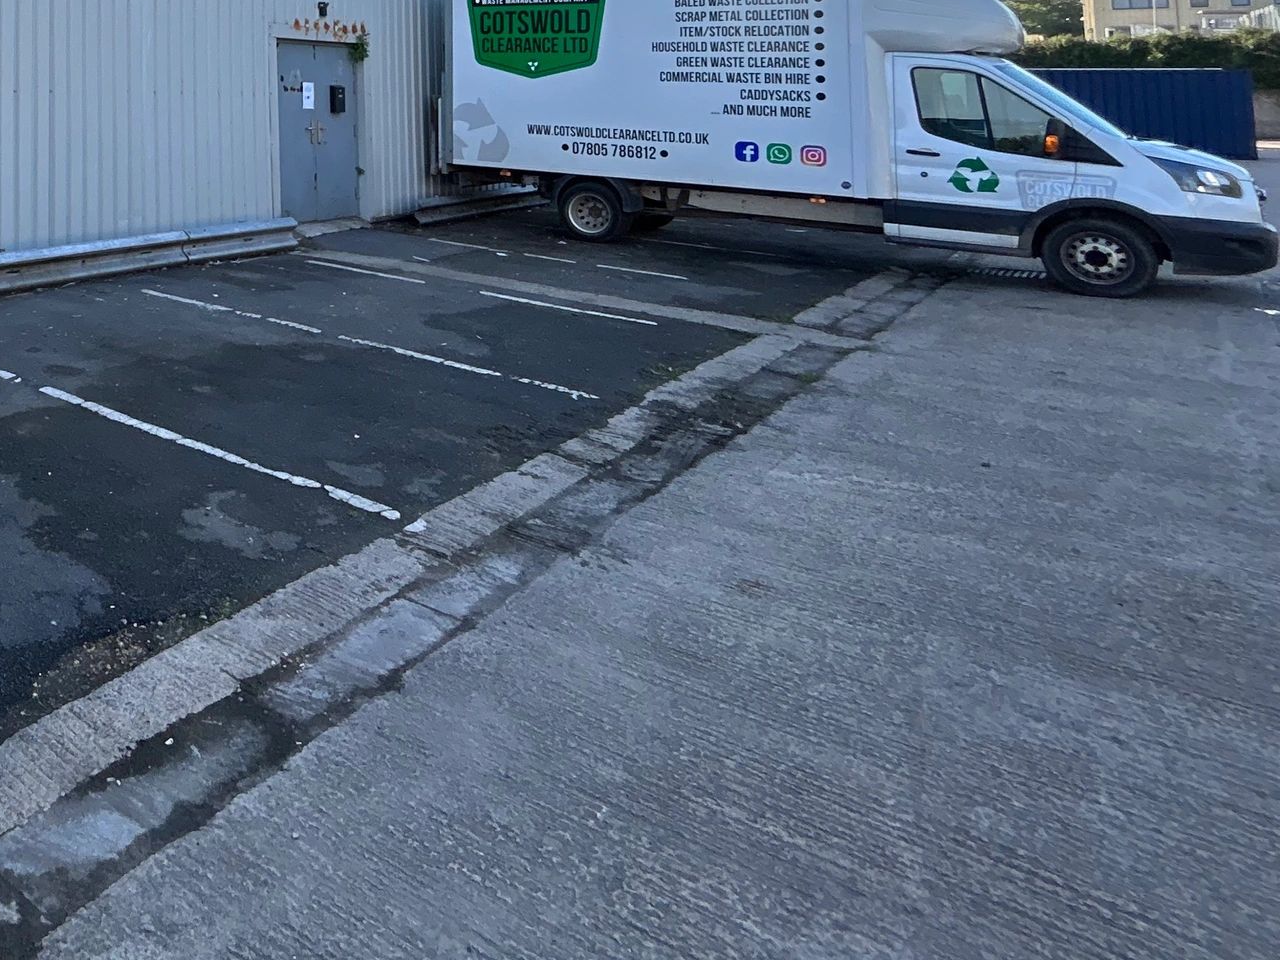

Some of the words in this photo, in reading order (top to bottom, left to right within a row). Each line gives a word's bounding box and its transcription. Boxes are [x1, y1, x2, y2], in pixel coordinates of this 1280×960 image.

[480, 9, 590, 34] COTSWOLD
[675, 11, 706, 22] SCRAP
[709, 10, 742, 22] METAL
[745, 9, 809, 21] COLLECTION
[680, 26, 742, 37] ITEM/STOCK
[745, 25, 810, 36] RELOCATION
[482, 37, 558, 53] CLEARANCE
[563, 37, 588, 53] LTD
[652, 41, 707, 52] HOUSEHOLD
[710, 41, 744, 52] WASTE
[747, 41, 810, 52] CLEARANCE
[676, 57, 707, 68] GREEN
[710, 57, 744, 68] WASTE
[748, 57, 810, 68] CLEARANCE
[660, 72, 723, 83] COMMERCIAL
[725, 72, 760, 84] WASTE
[764, 73, 782, 84] BIN
[785, 74, 810, 84] HIRE
[740, 89, 811, 101] CADDYSACKS
[747, 105, 777, 117] MUCH
[780, 106, 811, 118] MORE
[527, 124, 709, 145] WWW.COTSWOLDCLEARANCELTD.CO.UK
[572, 142, 608, 156] 07805
[611, 144, 656, 160] 786812
